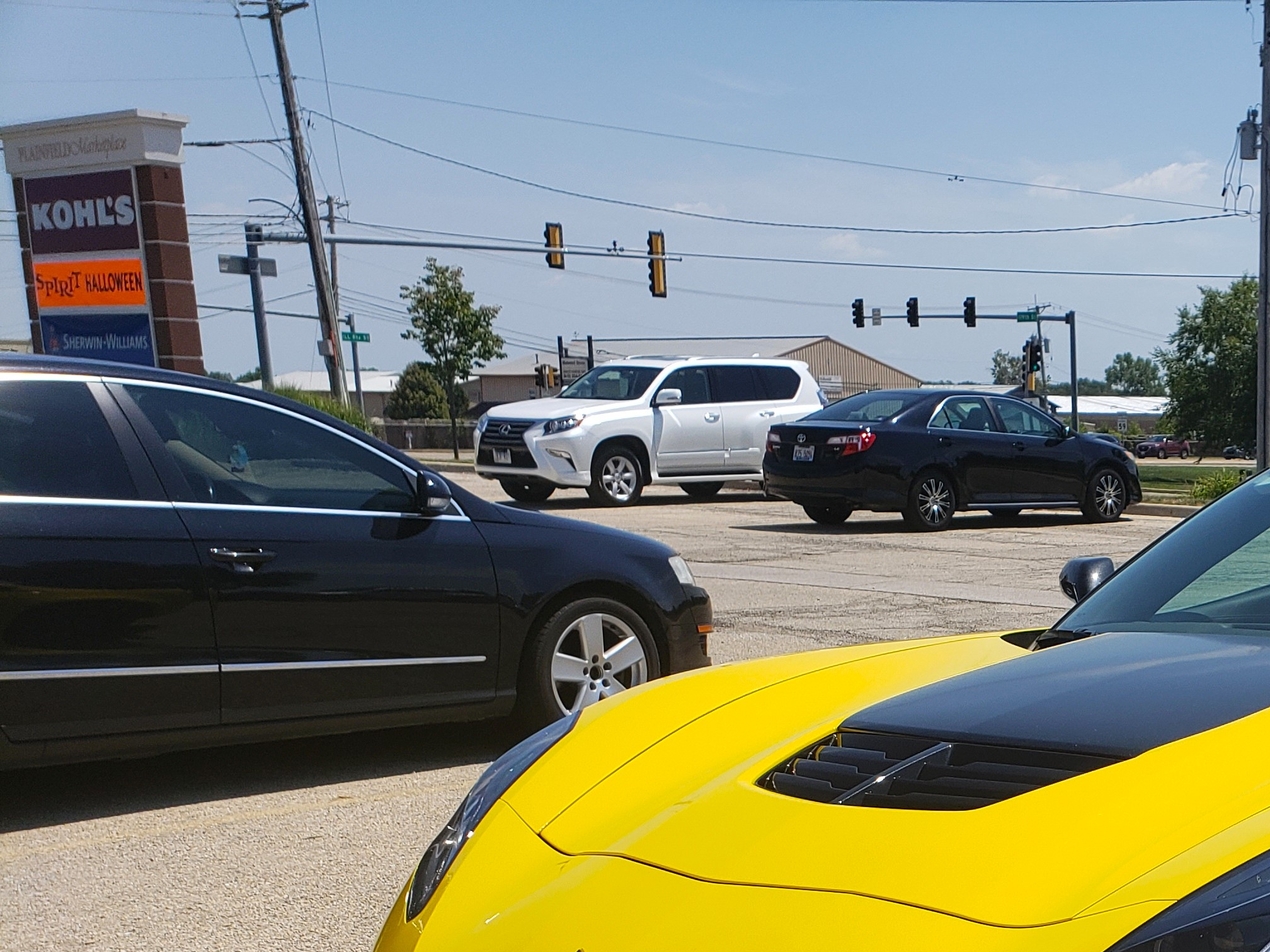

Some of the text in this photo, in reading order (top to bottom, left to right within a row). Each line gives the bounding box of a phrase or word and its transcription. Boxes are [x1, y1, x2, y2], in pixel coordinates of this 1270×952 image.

[31, 195, 135, 231] KOHL'S
[36, 271, 143, 297] SPIRIT HALLOWEEN
